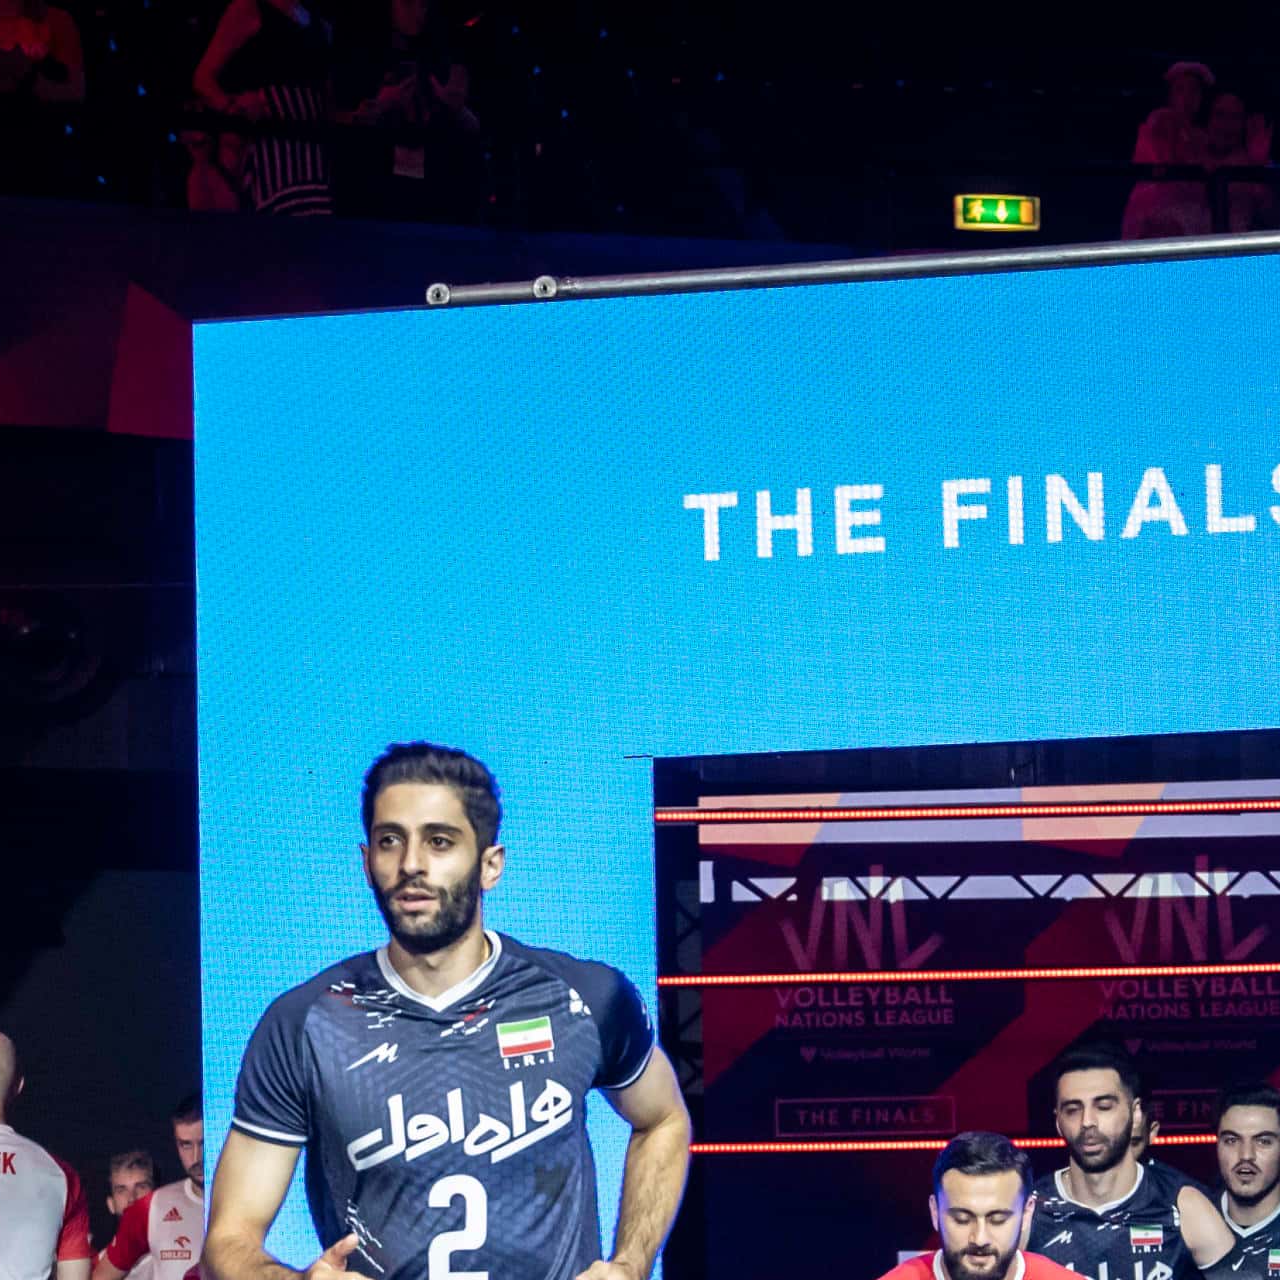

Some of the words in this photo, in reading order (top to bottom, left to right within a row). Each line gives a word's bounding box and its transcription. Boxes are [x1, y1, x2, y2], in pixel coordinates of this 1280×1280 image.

[683, 484, 886, 561] THE
[775, 984, 954, 1009] VOLLEYBALL
[1100, 976, 1280, 999] VOLLEYBALL
[775, 1010, 866, 1029] NATIONS
[875, 1007, 954, 1026] LEAGUE
[1099, 1001, 1191, 1021] NATIONS
[1200, 998, 1280, 1018] LEAGUE
[796, 1108, 840, 1127] THE
[850, 1106, 937, 1125] FINALS
